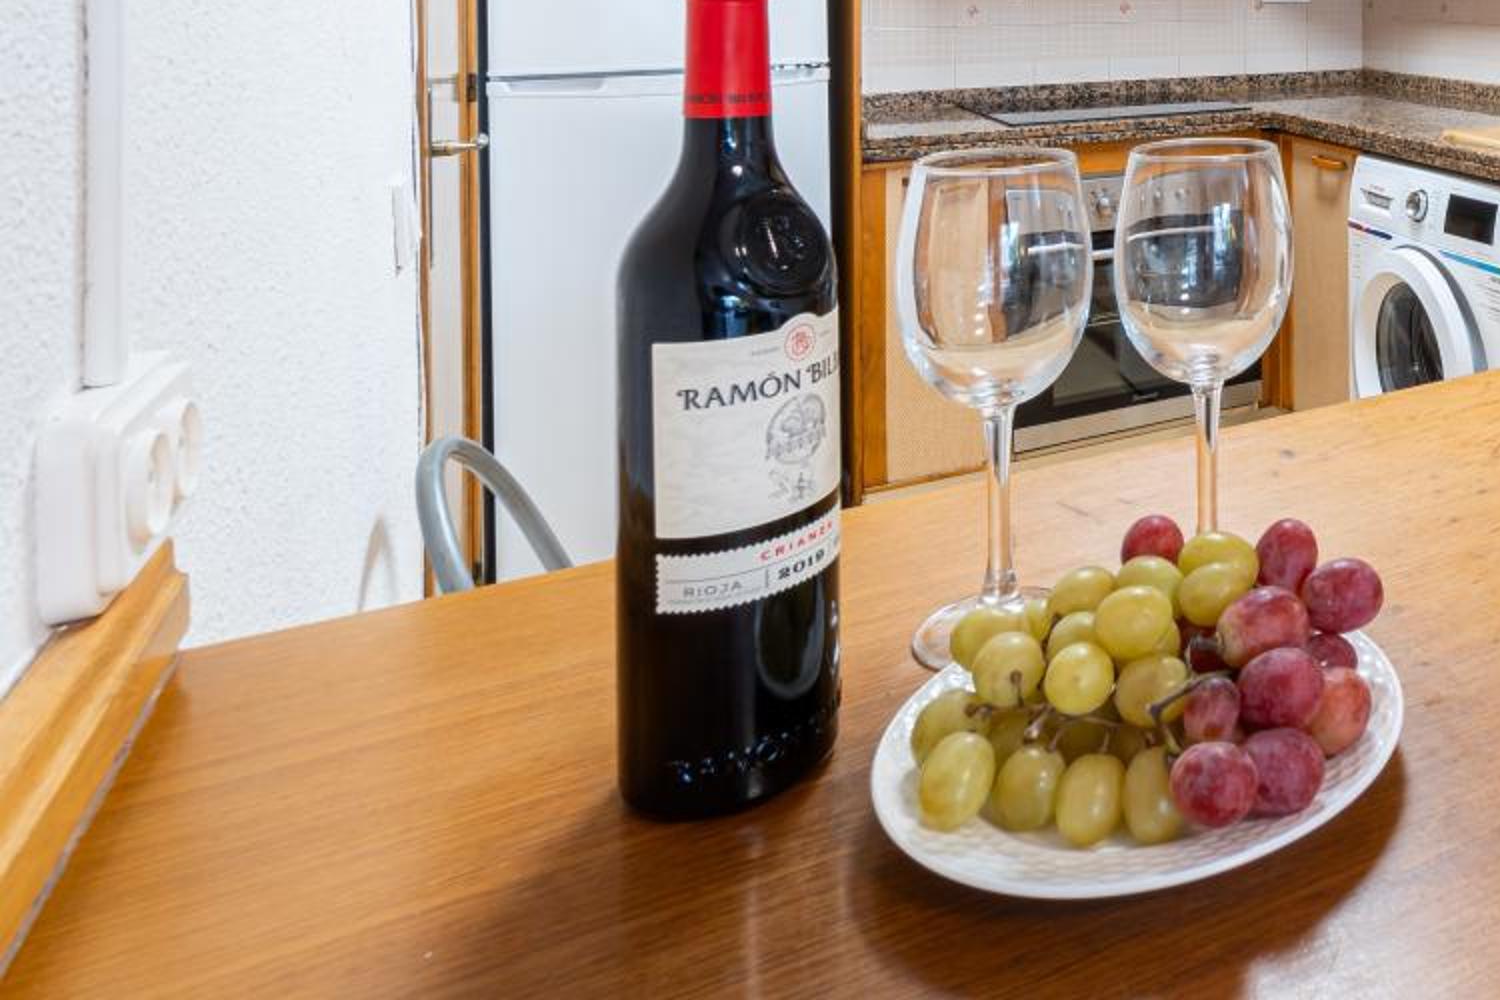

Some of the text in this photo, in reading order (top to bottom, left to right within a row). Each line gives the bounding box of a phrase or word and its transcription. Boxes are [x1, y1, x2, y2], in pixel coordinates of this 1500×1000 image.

[677, 369, 800, 411] RAMÓN
[778, 548, 825, 580] 2019
[682, 581, 743, 598] RIOJA
